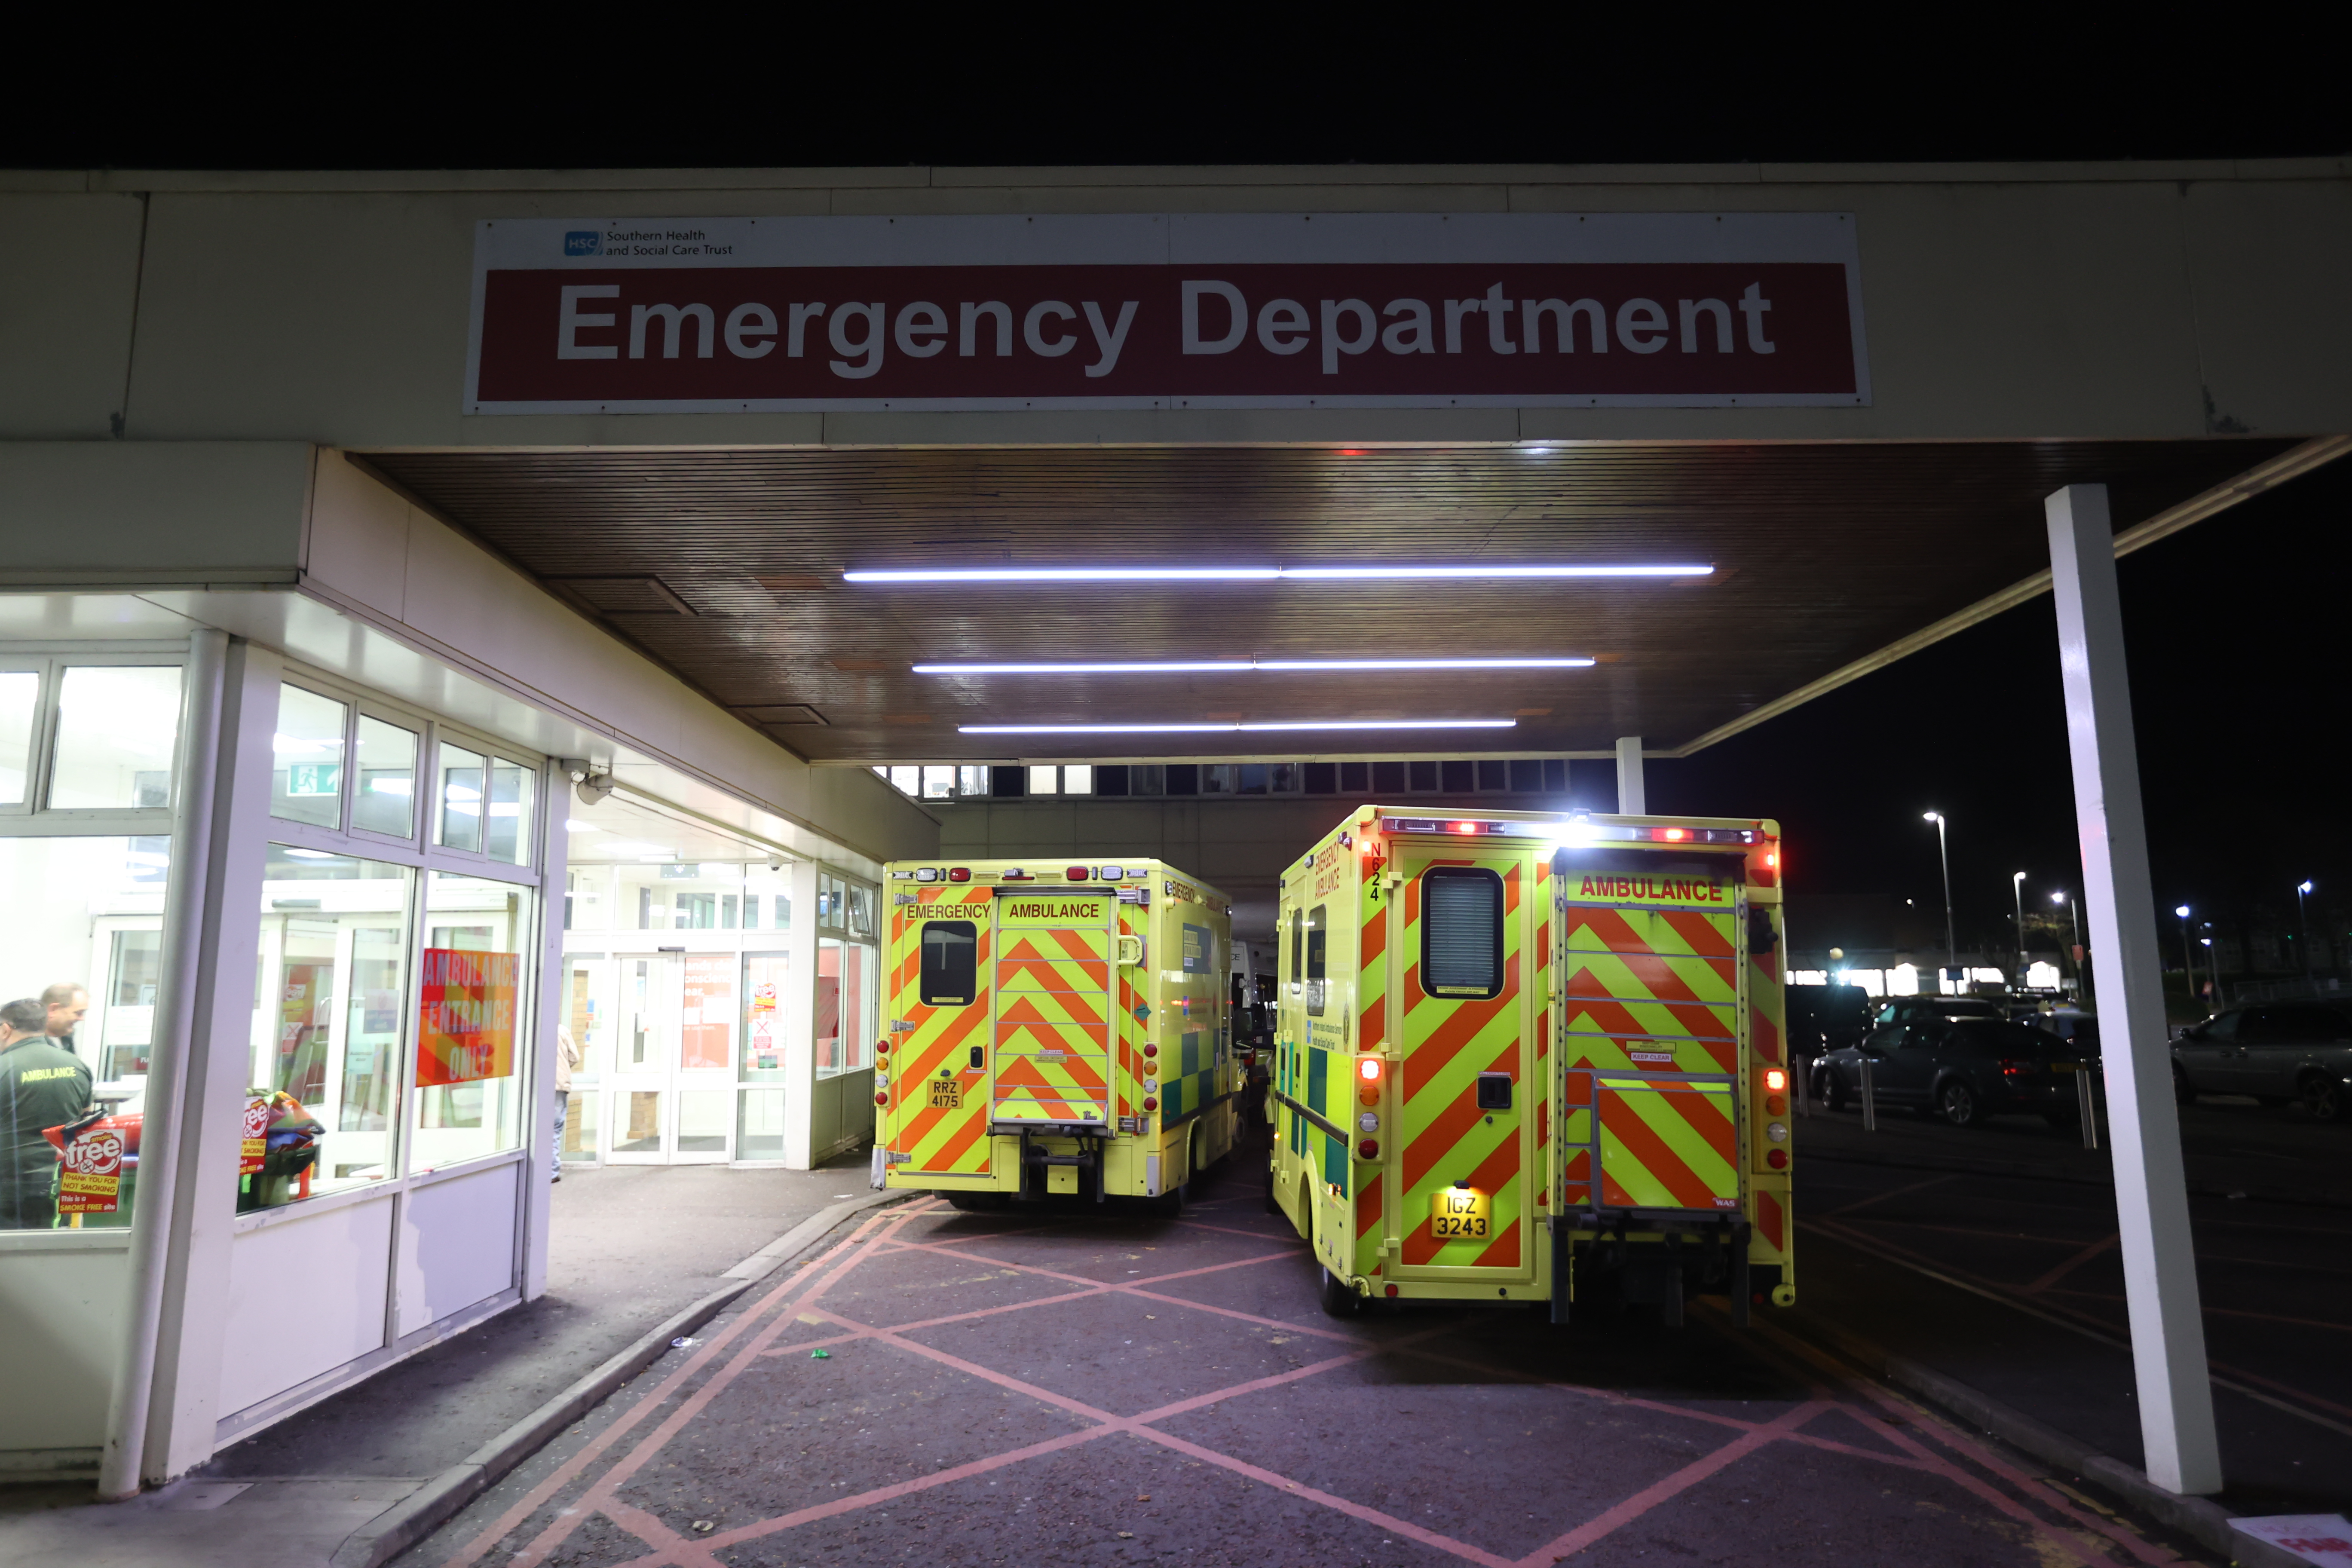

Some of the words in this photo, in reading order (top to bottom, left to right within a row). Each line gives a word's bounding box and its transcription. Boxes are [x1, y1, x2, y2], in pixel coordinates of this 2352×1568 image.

[569, 239, 597, 248] HSC
[607, 231, 662, 241] Southern
[667, 230, 705, 240] Health
[606, 245, 629, 255] and
[634, 245, 668, 255] Social
[673, 245, 699, 255] Care
[704, 245, 732, 254] Trust
[557, 285, 1139, 379] Emergency
[1181, 279, 1776, 374] Department
[1316, 841, 1339, 876] EMERGENCY
[1173, 880, 1194, 903] EMERGENCY
[1315, 867, 1339, 900] AMBULANCE
[1580, 876, 1723, 901] AMBULANCE
[907, 904, 991, 918] EMERGENCY
[1009, 904, 1099, 918] AMBULANCE
[424, 952, 518, 987] AMBULANCE
[686, 960, 712, 971] ands
[685, 973, 731, 983] onscienc
[684, 988, 704, 996] ear.
[755, 984, 775, 996] free
[428, 999, 510, 1034] ENTRANCE
[449, 1044, 489, 1081] ONLY
[21, 1066, 77, 1084] AMBULANCE
[934, 1081, 957, 1093] RRZ
[932, 1095, 958, 1107] 4175
[243, 1104, 267, 1127] ree
[67, 1138, 120, 1165] free
[80, 1183, 116, 1193] SMOKING
[1447, 1197, 1476, 1214] IGZ
[1437, 1217, 1486, 1235] 3243
